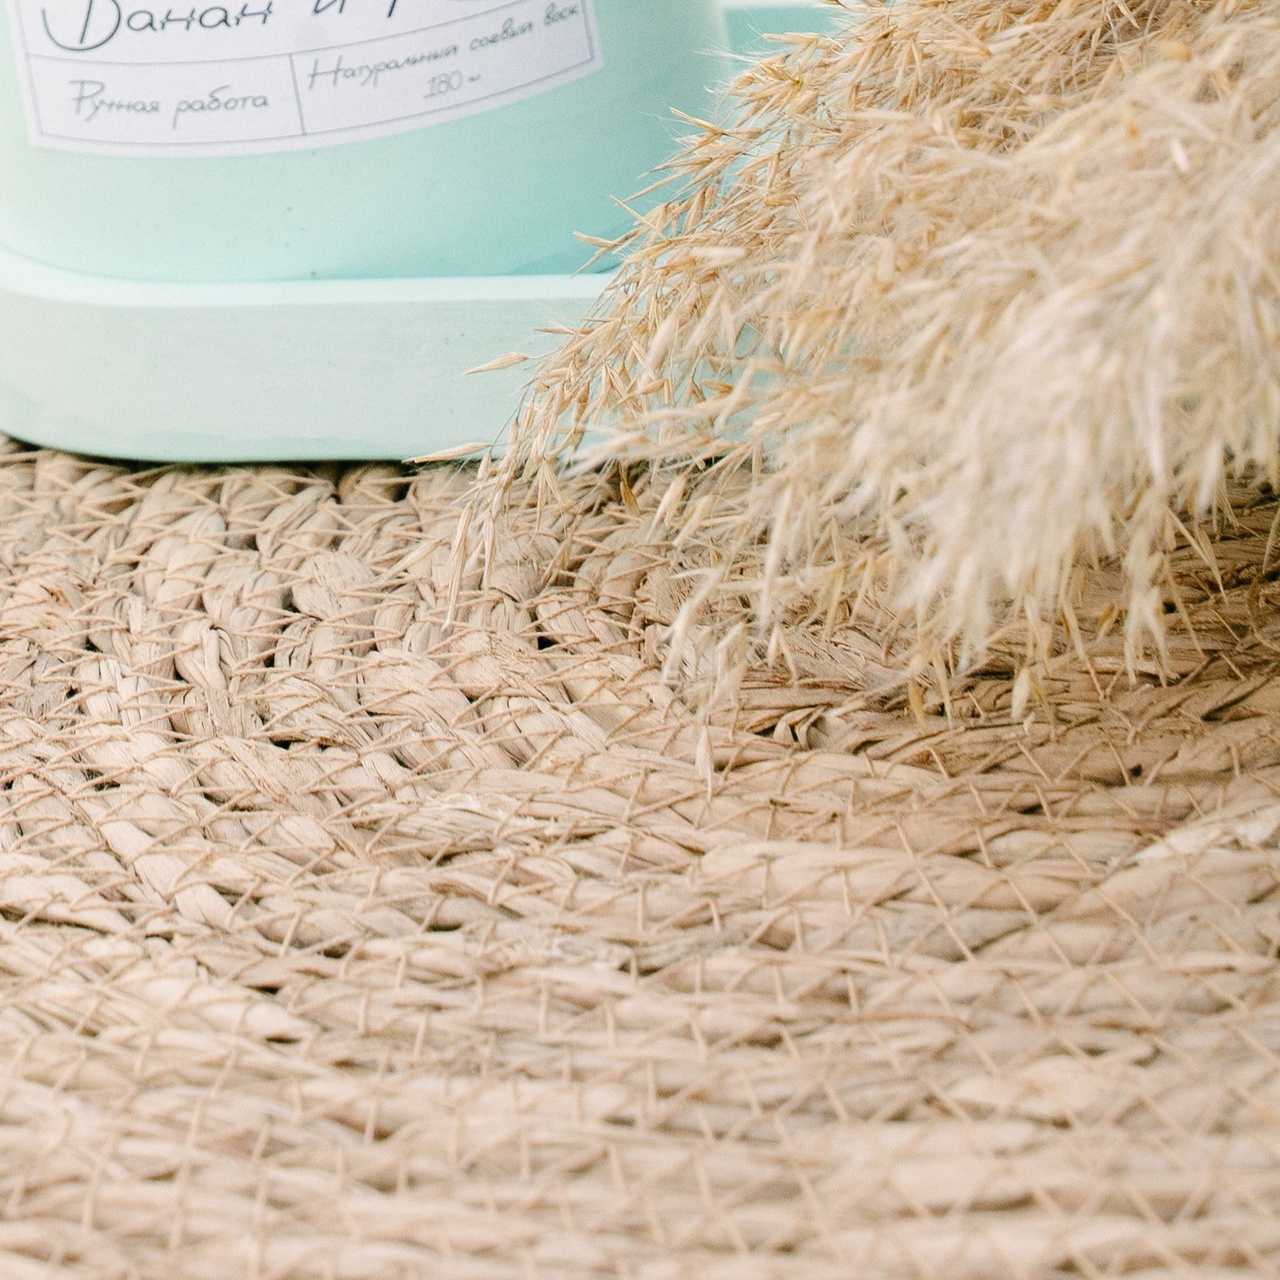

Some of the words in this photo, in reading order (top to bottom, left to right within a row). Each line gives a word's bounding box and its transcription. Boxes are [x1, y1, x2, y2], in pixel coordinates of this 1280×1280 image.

[67, 79, 161, 122] Ручная
[171, 84, 269, 130] работа
[423, 69, 463, 100] 180
